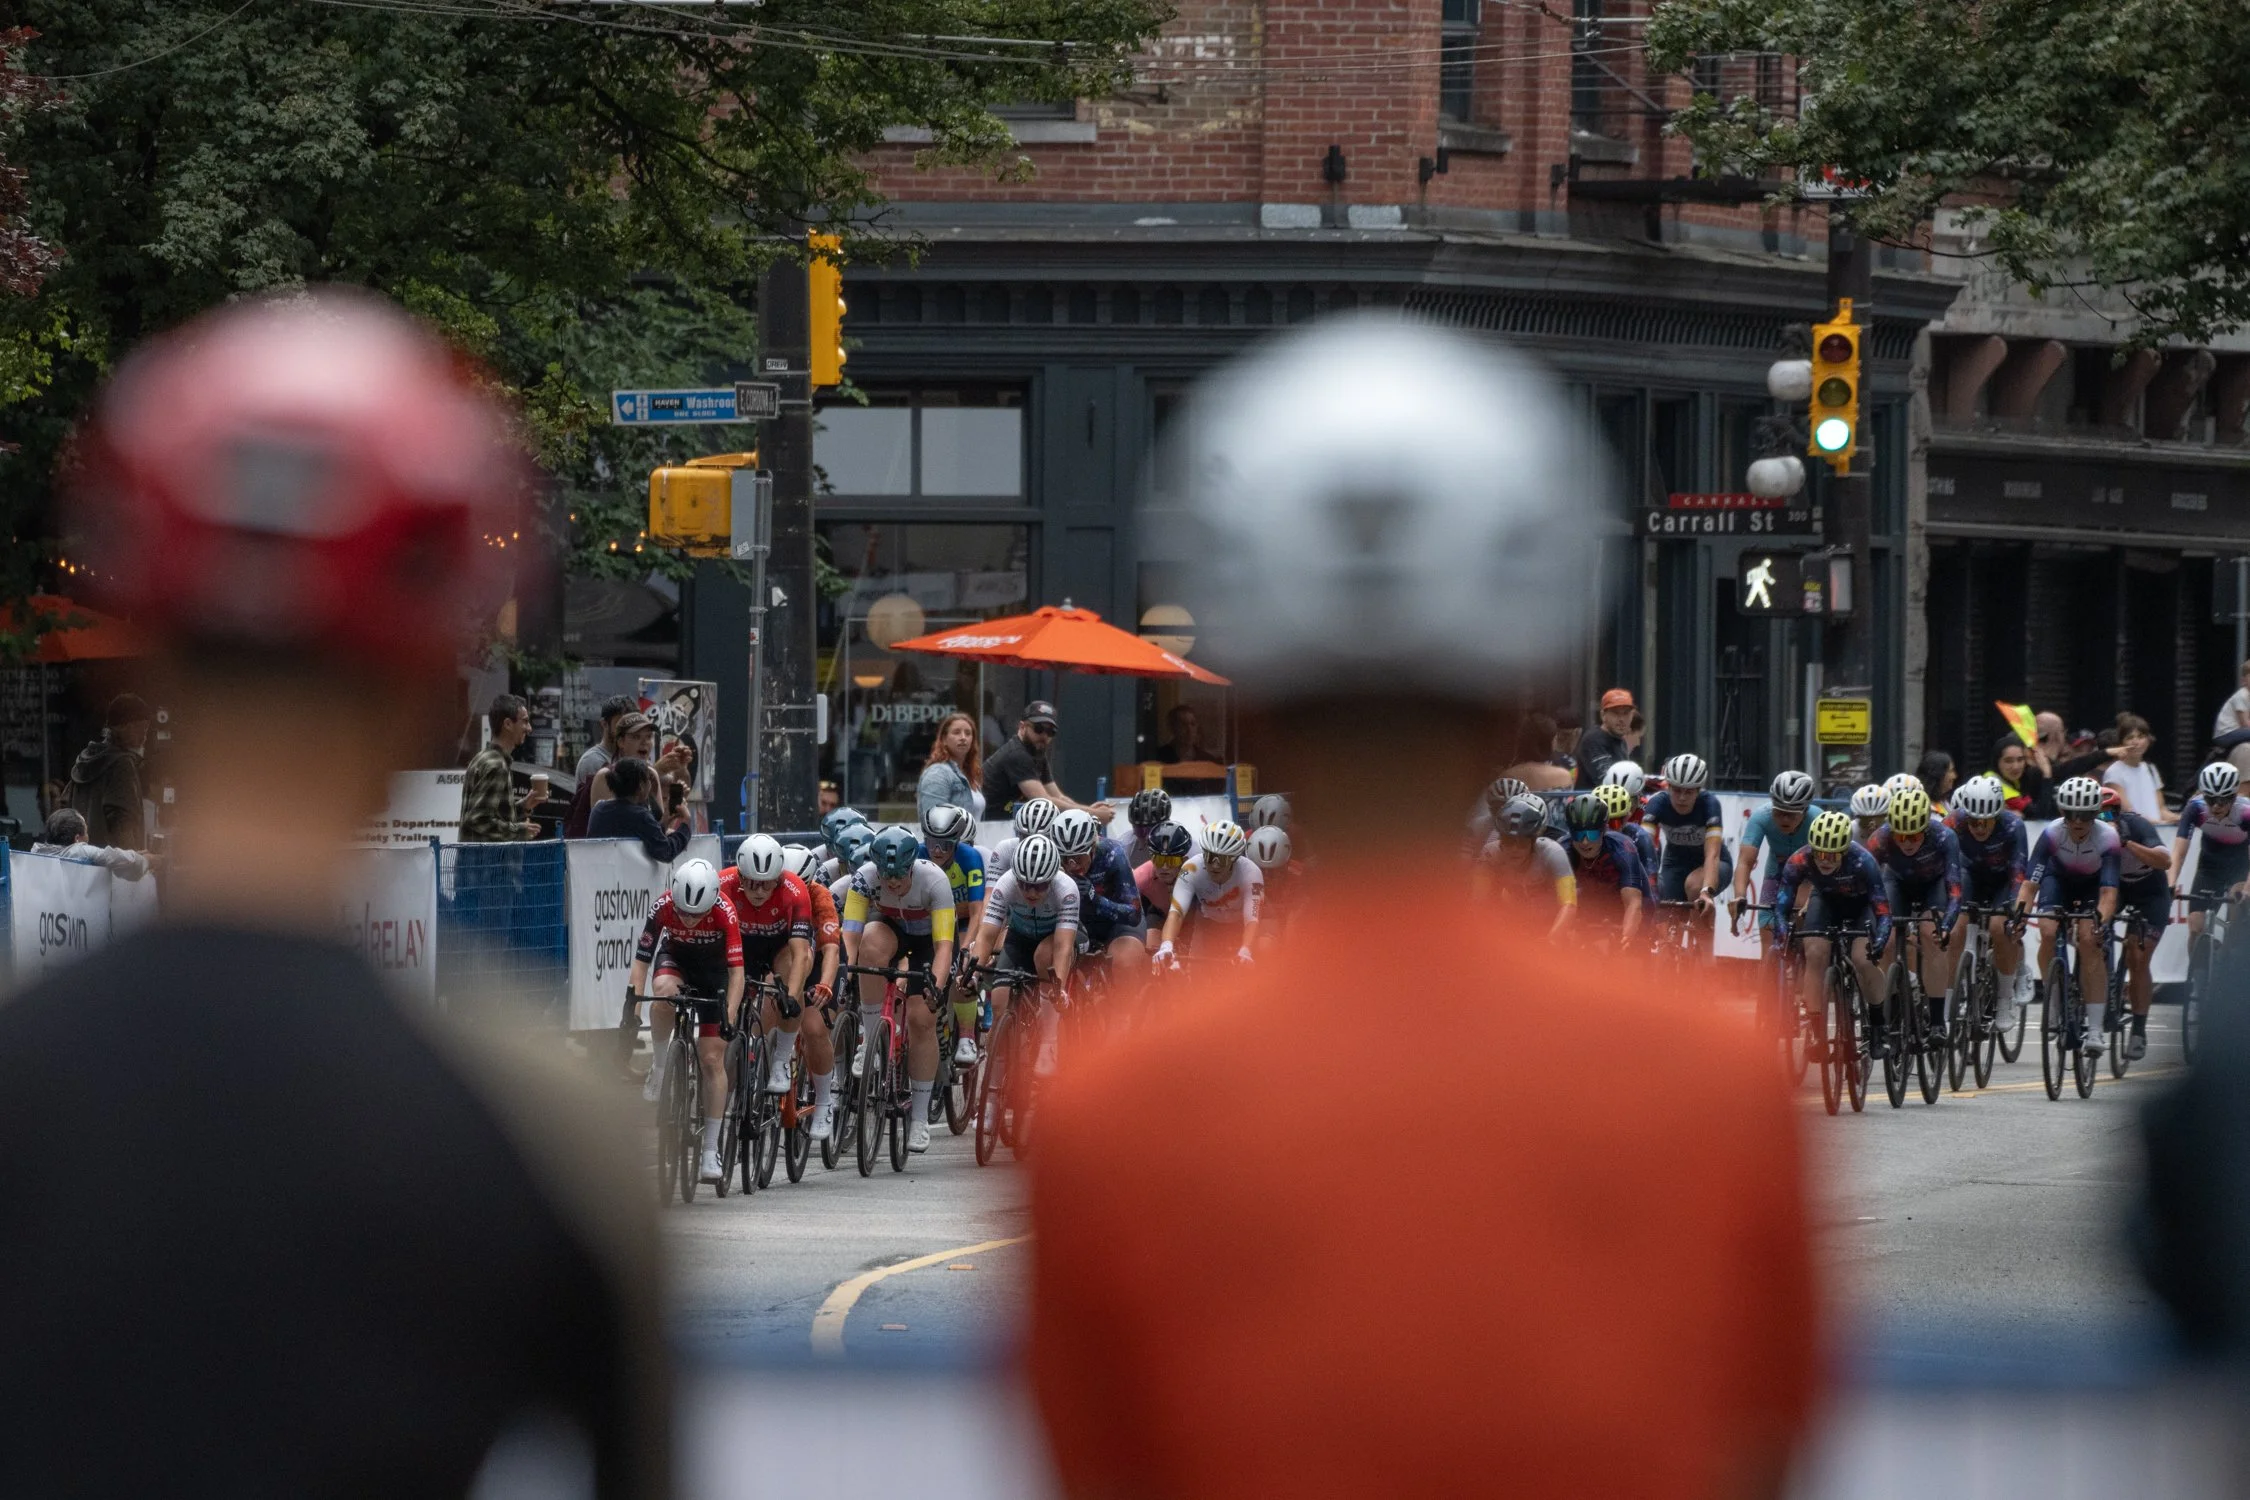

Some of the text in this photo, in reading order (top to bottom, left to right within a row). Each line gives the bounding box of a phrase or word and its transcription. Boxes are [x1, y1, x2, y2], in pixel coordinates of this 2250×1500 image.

[1649, 511, 1735, 532] Carrall
[1751, 511, 1774, 532] St
[392, 819, 460, 830] Departmen
[783, 878, 801, 897] MOSAIC
[595, 881, 650, 932] gastown
[648, 895, 672, 920] MOSA
[715, 895, 737, 925] OSAIC
[596, 926, 633, 980] grand
